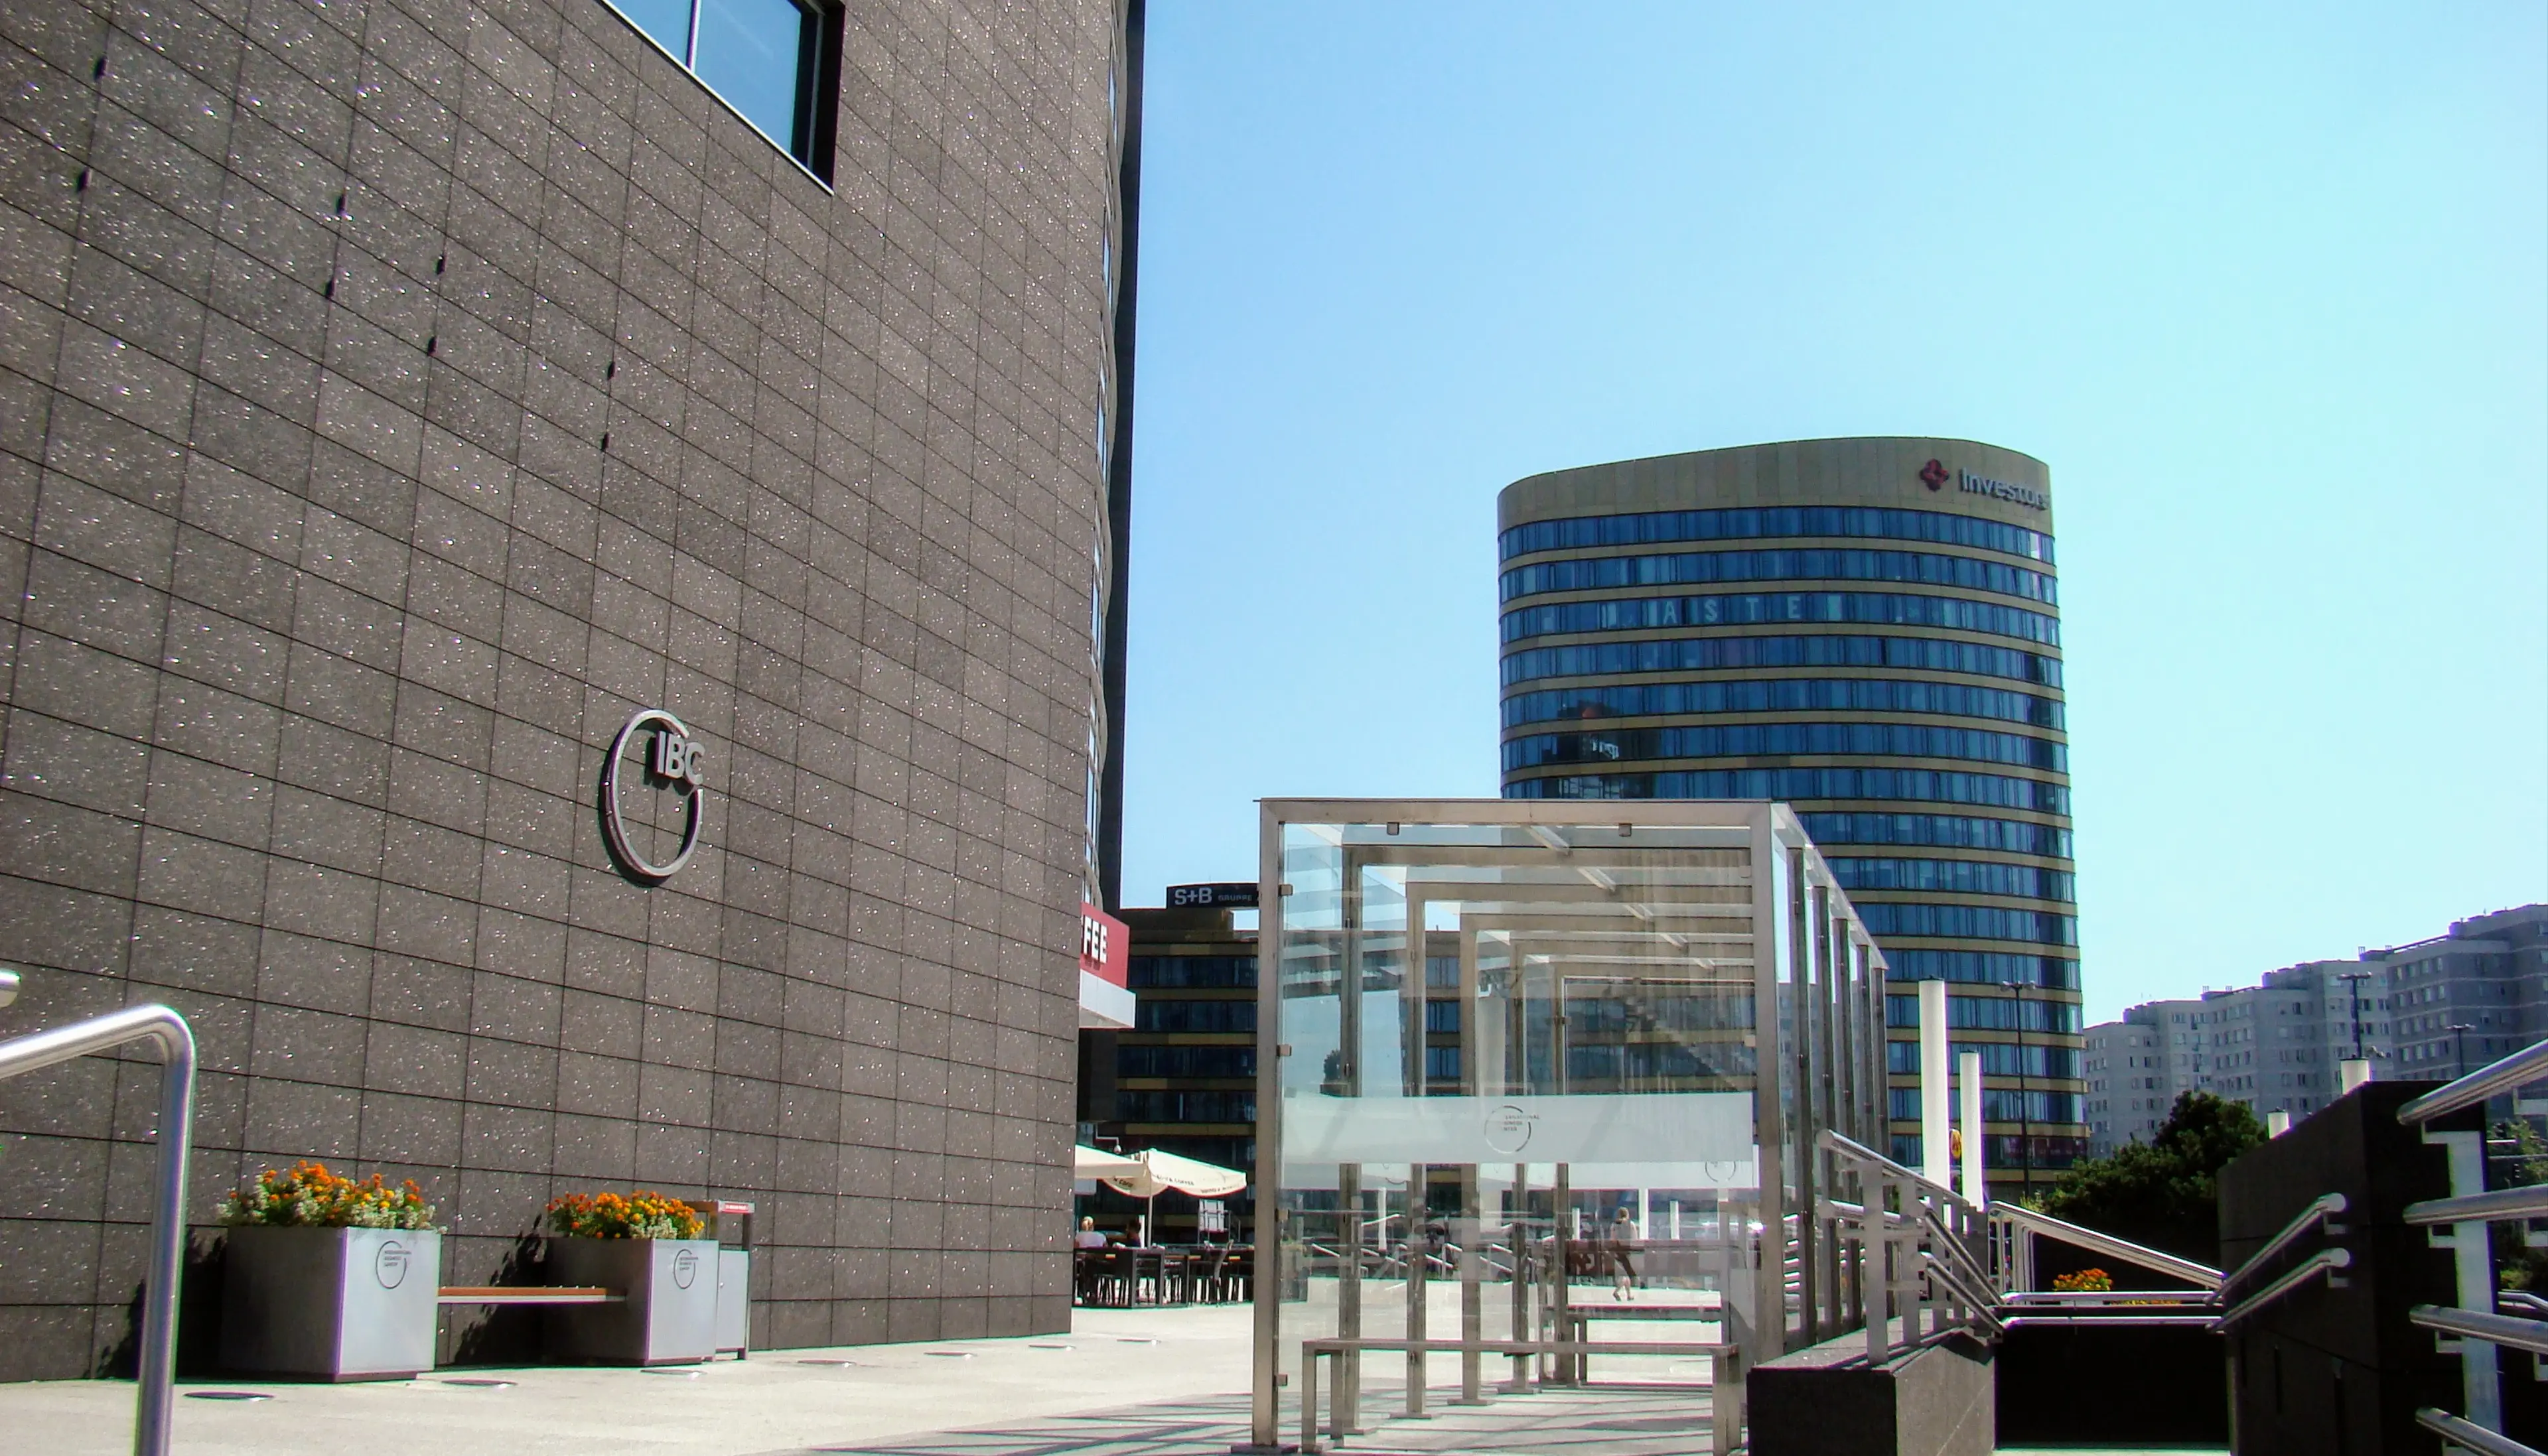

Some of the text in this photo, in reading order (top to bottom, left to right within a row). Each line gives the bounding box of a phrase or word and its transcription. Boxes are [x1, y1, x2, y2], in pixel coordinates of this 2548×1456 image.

[657, 730, 705, 785] IBC
[1174, 887, 1212, 905] S+B
[1081, 914, 1107, 964] FEE
